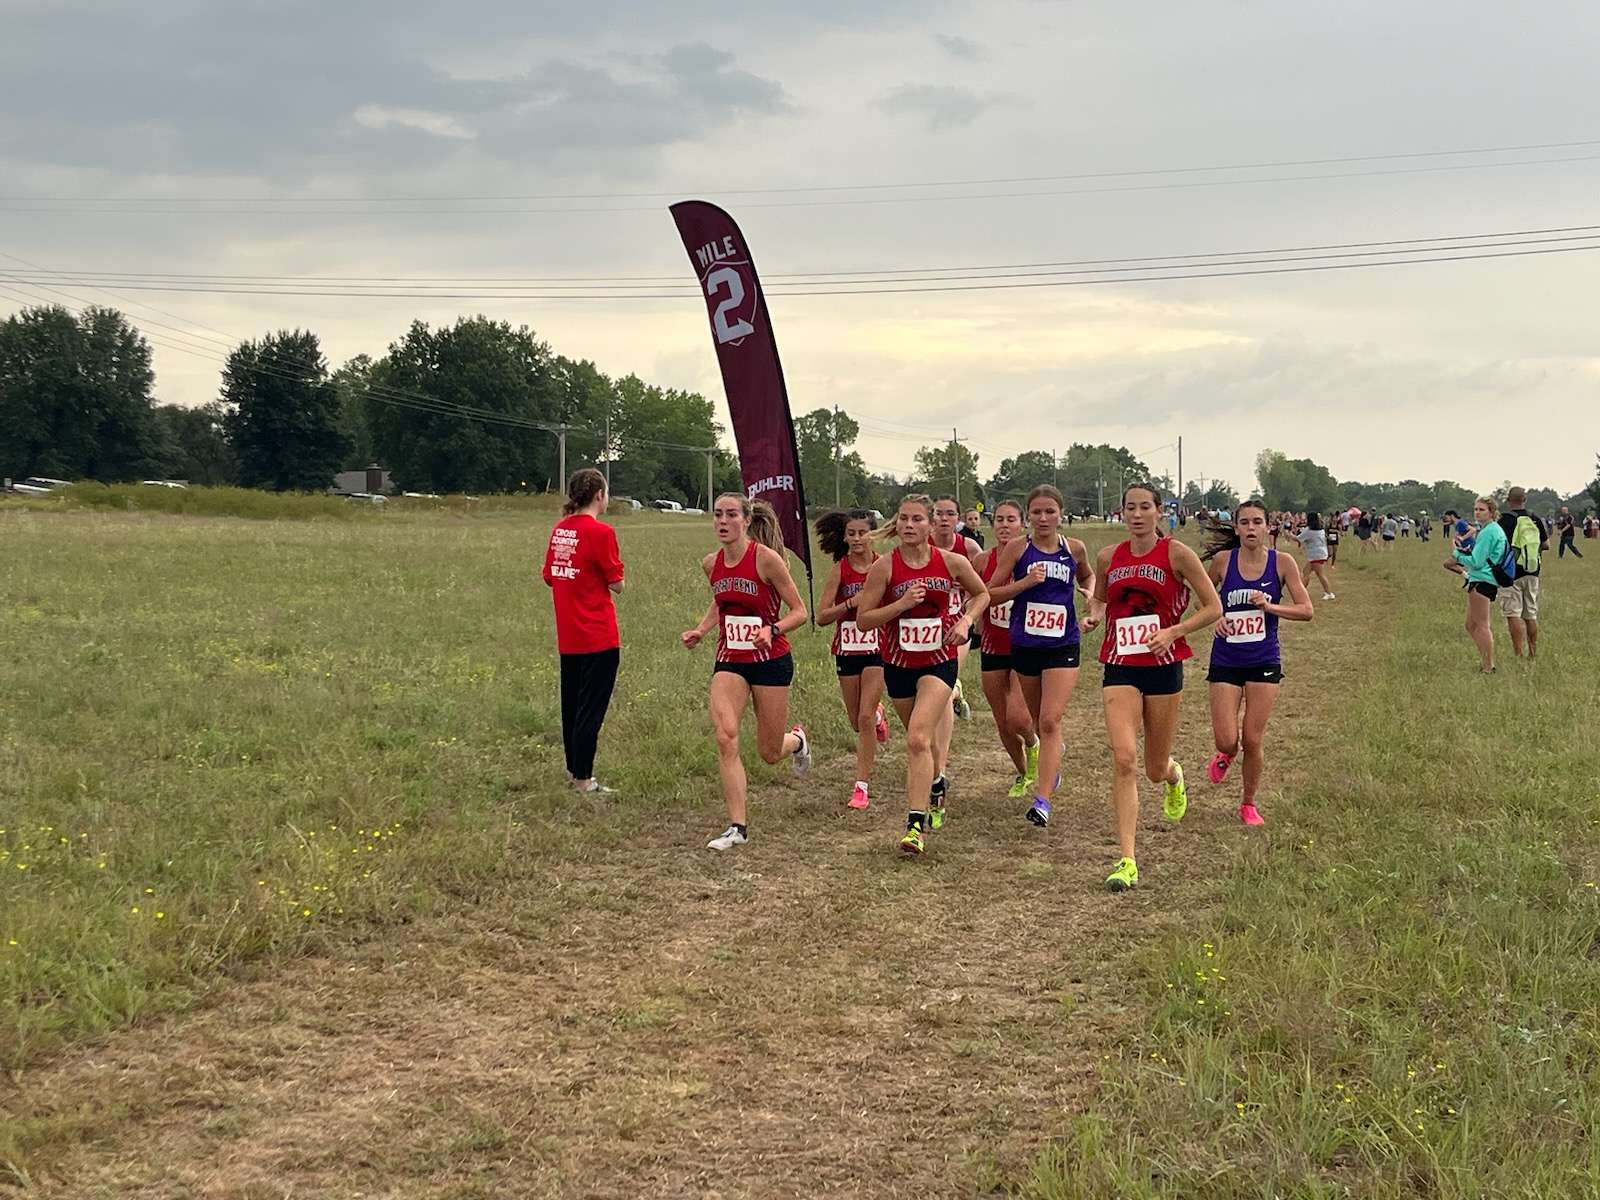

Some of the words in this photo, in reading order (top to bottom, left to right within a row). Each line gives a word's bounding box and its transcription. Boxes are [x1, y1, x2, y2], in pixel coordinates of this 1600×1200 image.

[696, 236, 736, 268] MILE
[707, 267, 754, 344] 2
[748, 475, 794, 500] BUHLER
[556, 529, 577, 538] CROSS
[1138, 564, 1167, 586] BEND
[733, 577, 758, 596] BEND
[1027, 609, 1065, 631] 3254
[1226, 616, 1264, 636] 3262
[901, 625, 940, 644] 3127
